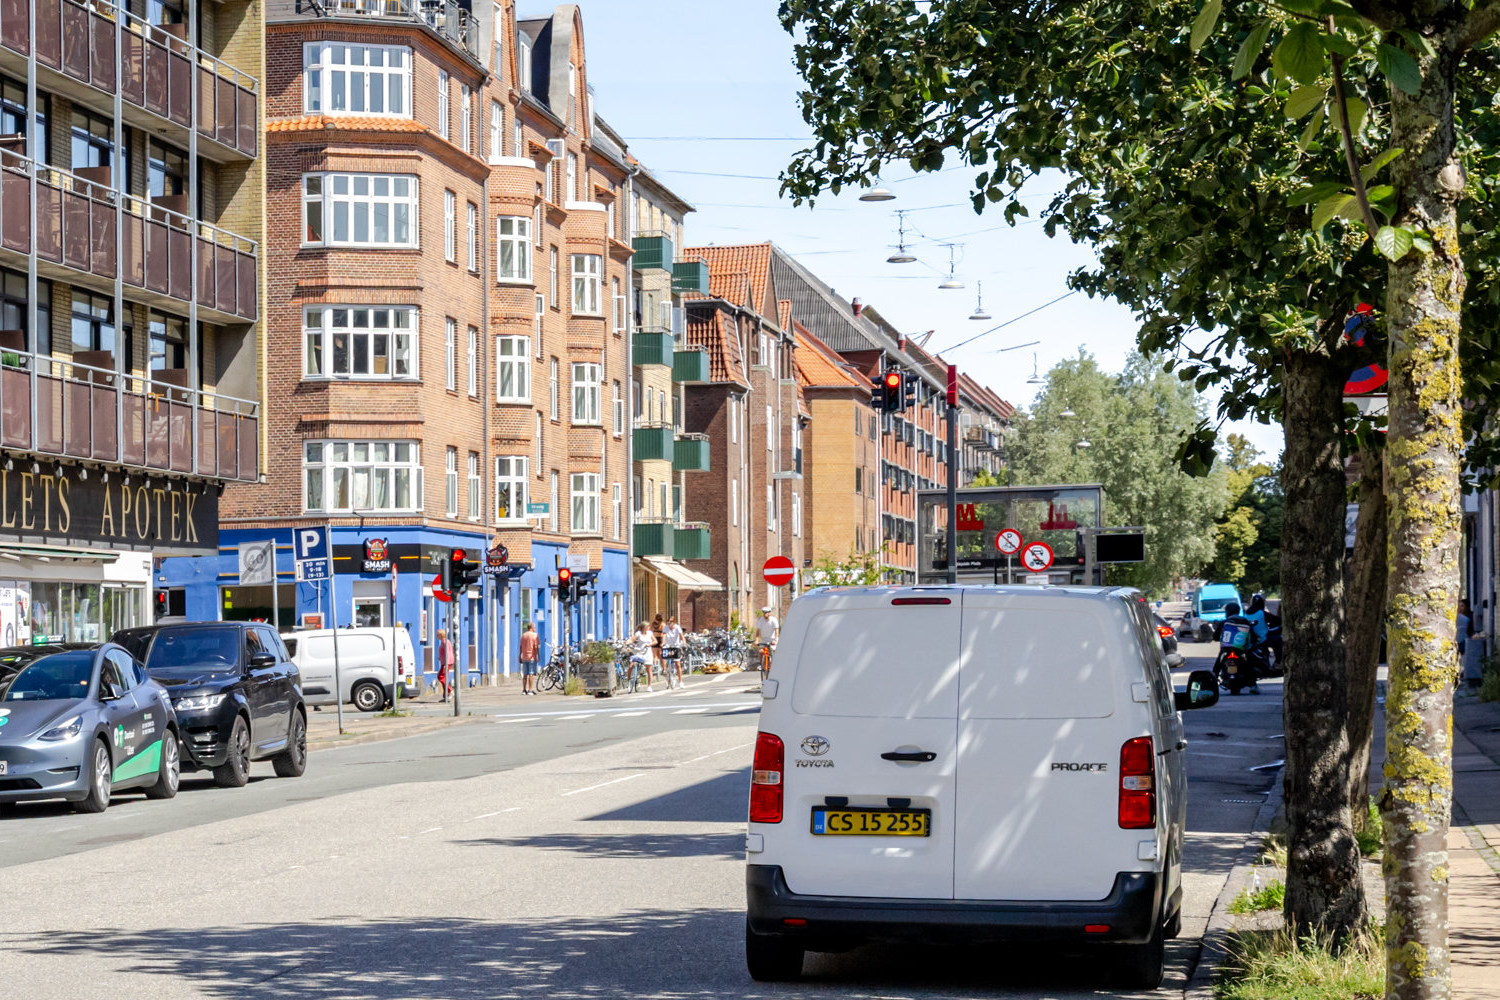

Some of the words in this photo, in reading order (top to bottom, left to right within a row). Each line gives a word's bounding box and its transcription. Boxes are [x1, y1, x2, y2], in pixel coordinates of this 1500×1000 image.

[100, 481, 199, 543] APOTEK
[301, 530, 320, 557] P
[364, 560, 391, 569] SMASH
[484, 565, 510, 573] SMASH
[795, 759, 835, 768] TOYOTA
[1051, 762, 1108, 772] PROACE
[827, 813, 853, 832] CS
[860, 813, 882, 832] 15
[886, 814, 922, 832] 255
